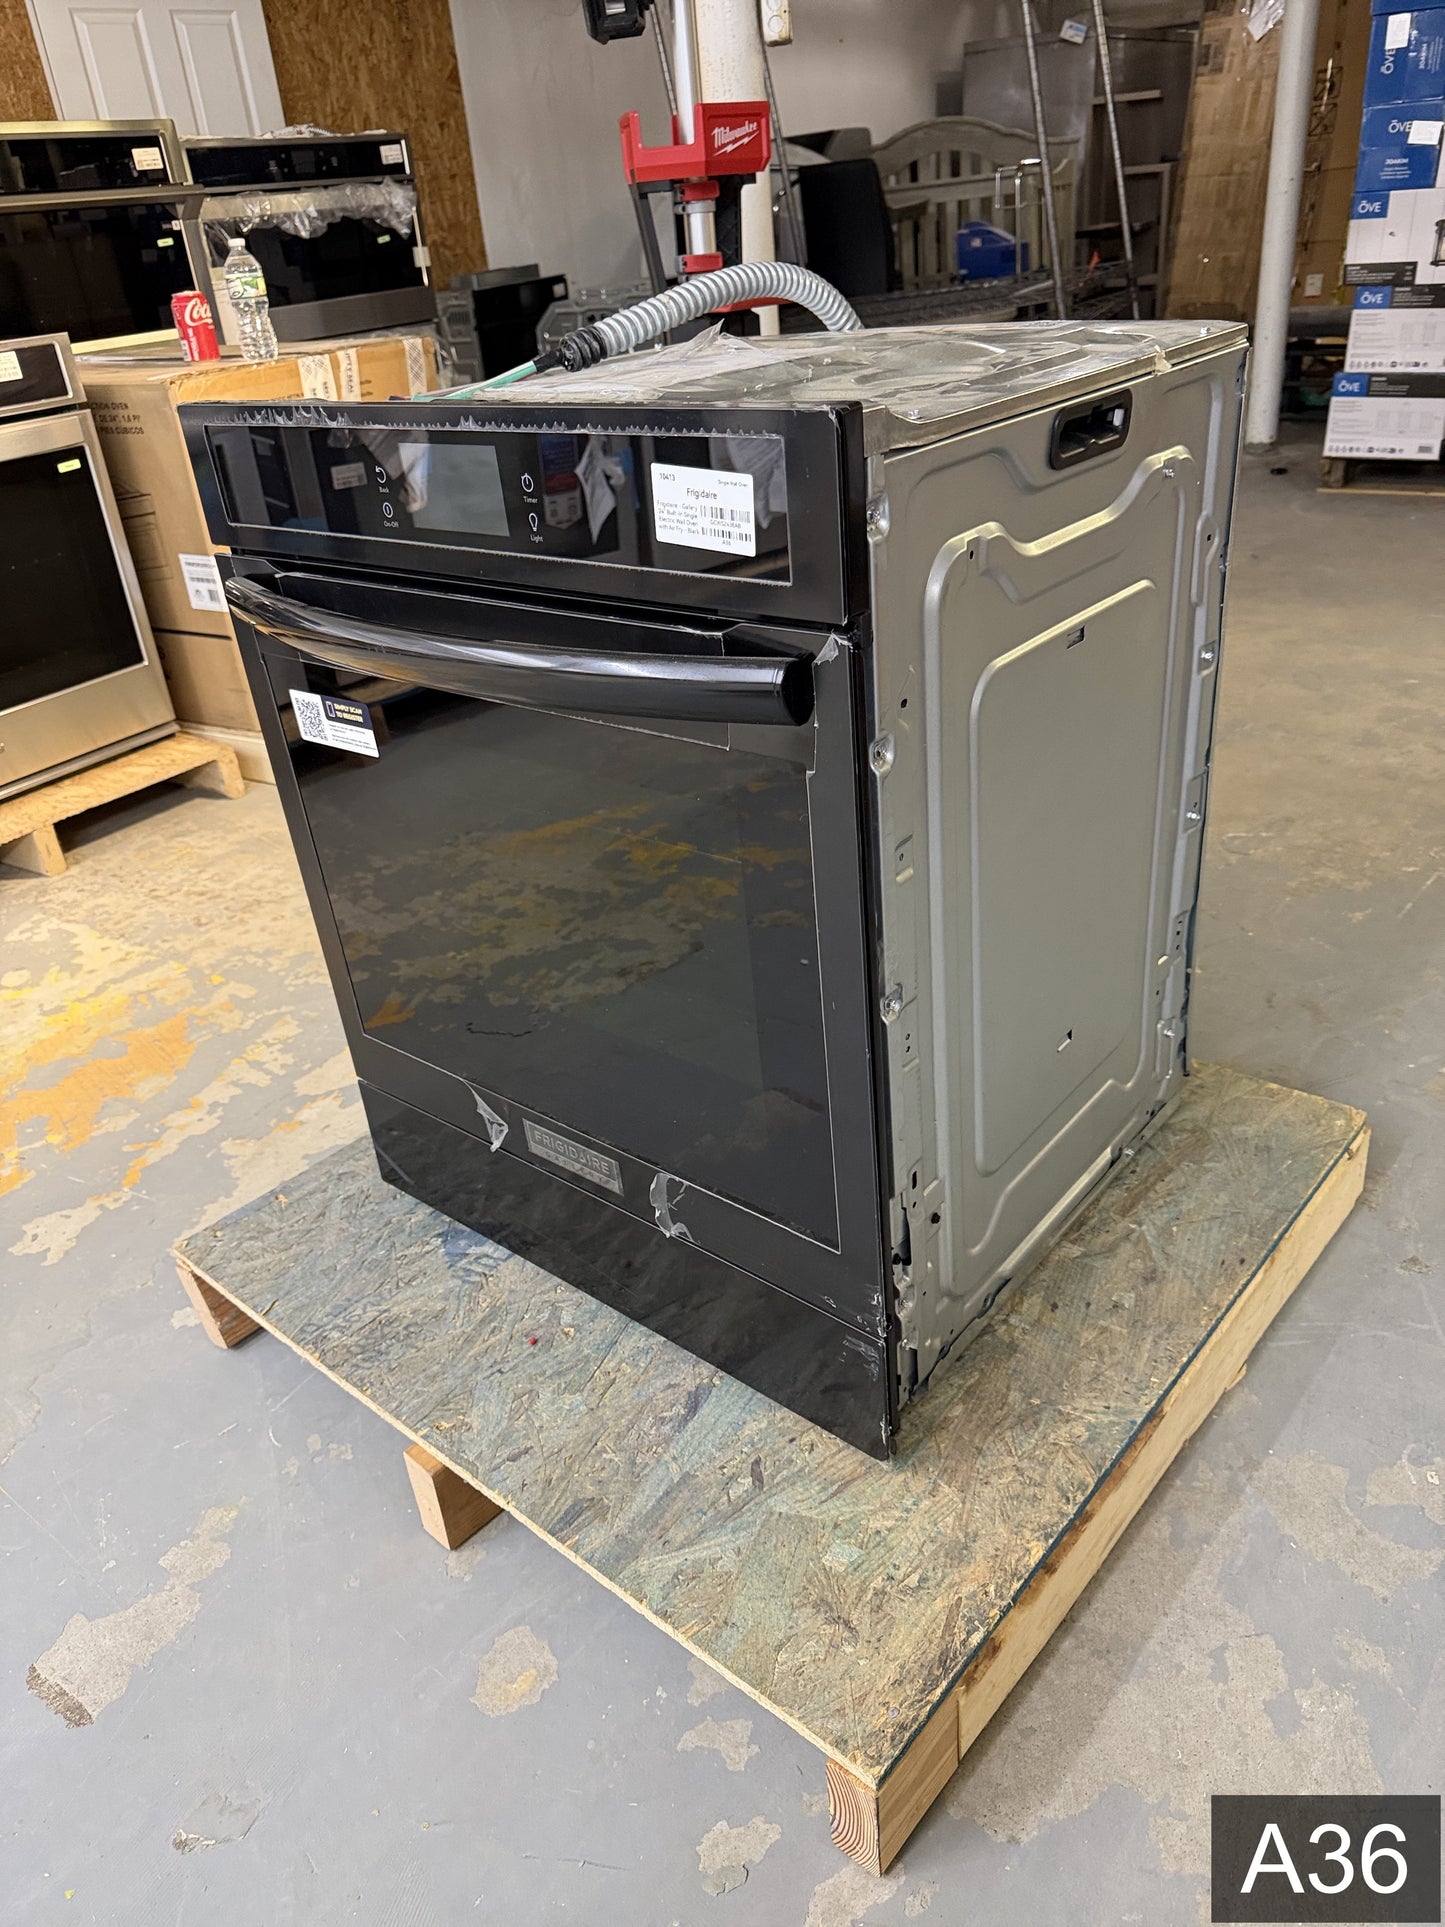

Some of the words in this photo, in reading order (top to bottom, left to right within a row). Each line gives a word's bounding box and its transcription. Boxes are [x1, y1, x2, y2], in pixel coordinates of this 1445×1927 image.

[711, 120, 759, 149] Milwaukee
[659, 473, 676, 482] 10413
[686, 487, 718, 500] Frigidaire
[523, 495, 539, 504] Timer
[530, 534, 544, 544] Light
[533, 1129, 611, 1175] FRIGIDAIRE
